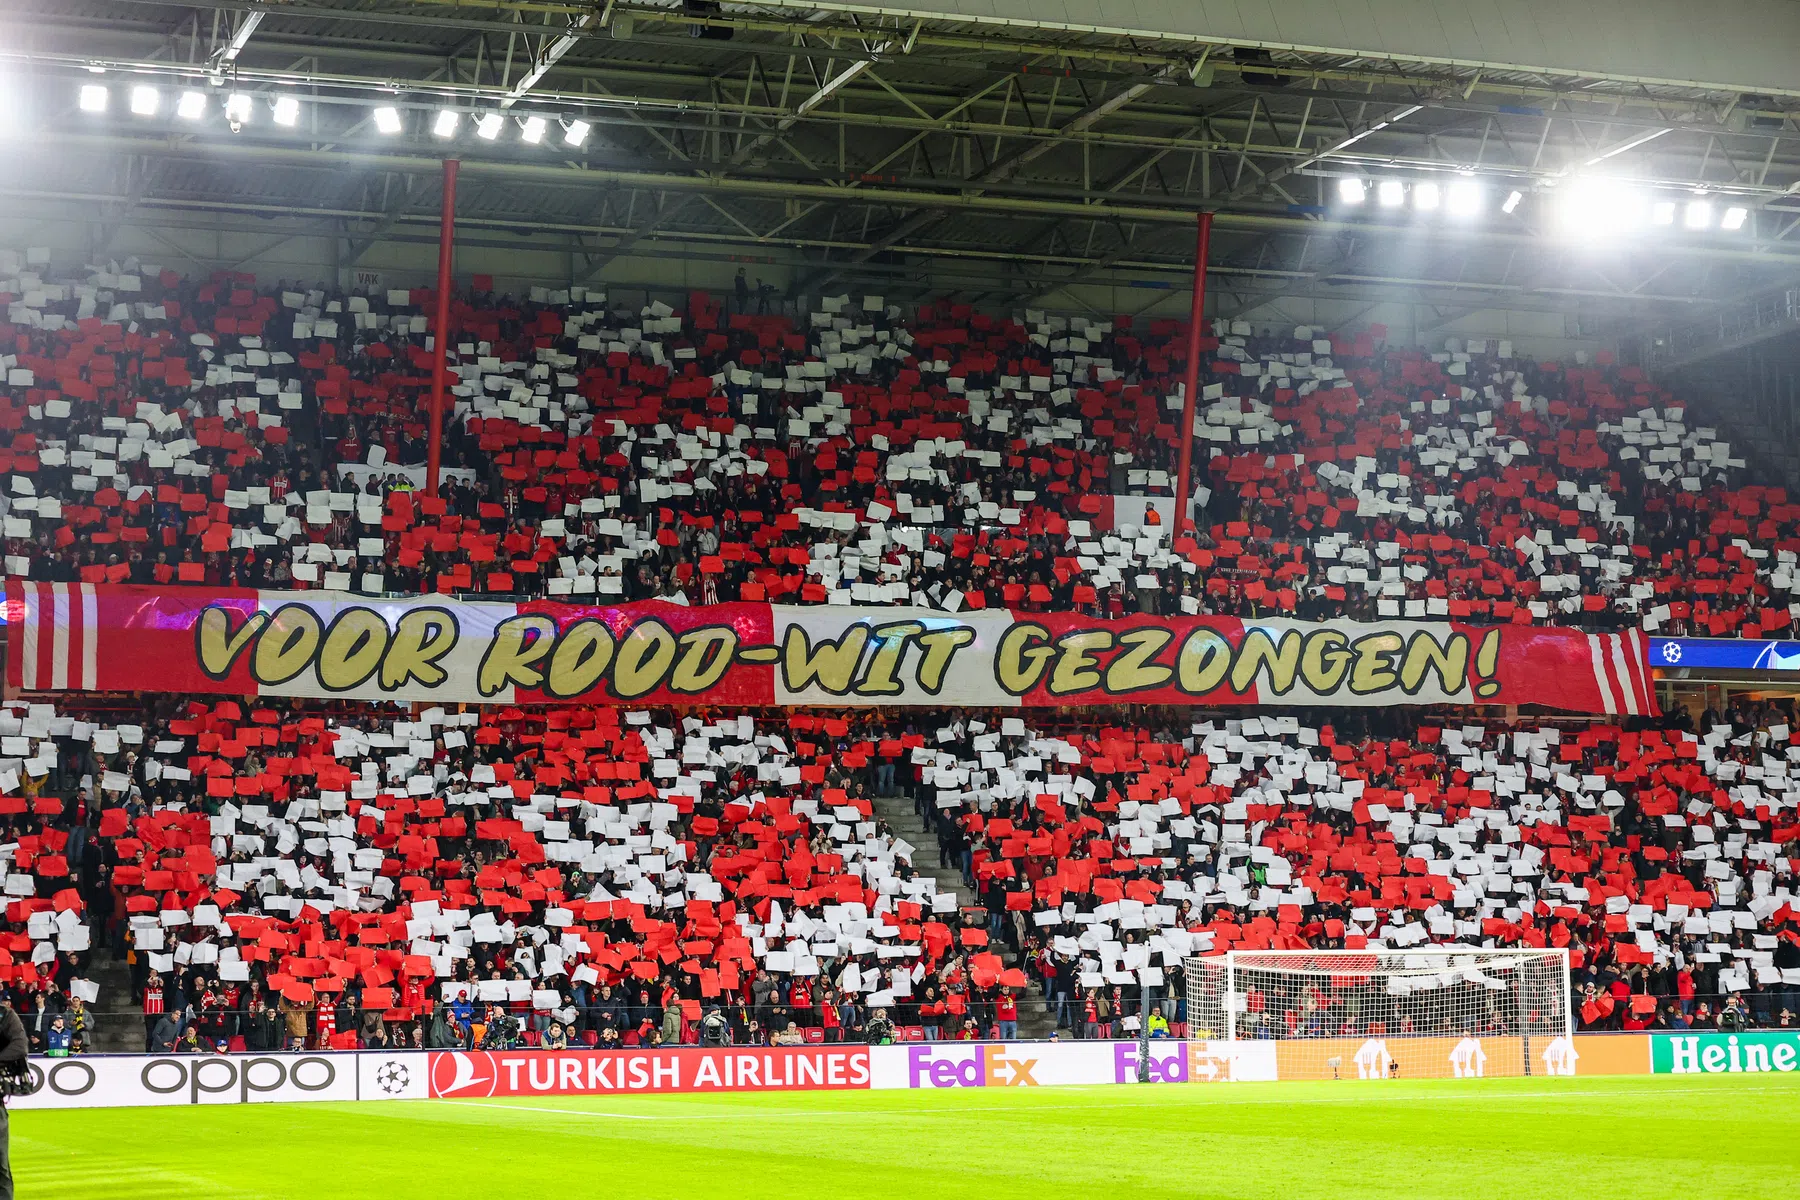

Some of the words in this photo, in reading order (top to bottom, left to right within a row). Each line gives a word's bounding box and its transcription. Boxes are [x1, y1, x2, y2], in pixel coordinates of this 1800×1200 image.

[358, 273, 378, 285] VAK
[195, 602, 459, 691] VOOR
[477, 612, 976, 699] ROOD-WIT
[994, 621, 1502, 699] GEZONGEN!
[502, 1055, 680, 1091] TURKISH
[693, 1053, 870, 1088] AIRLINES
[909, 1044, 1040, 1088] FedEx
[1669, 1035, 1800, 1073] Heine
[141, 1057, 336, 1103] oppo
